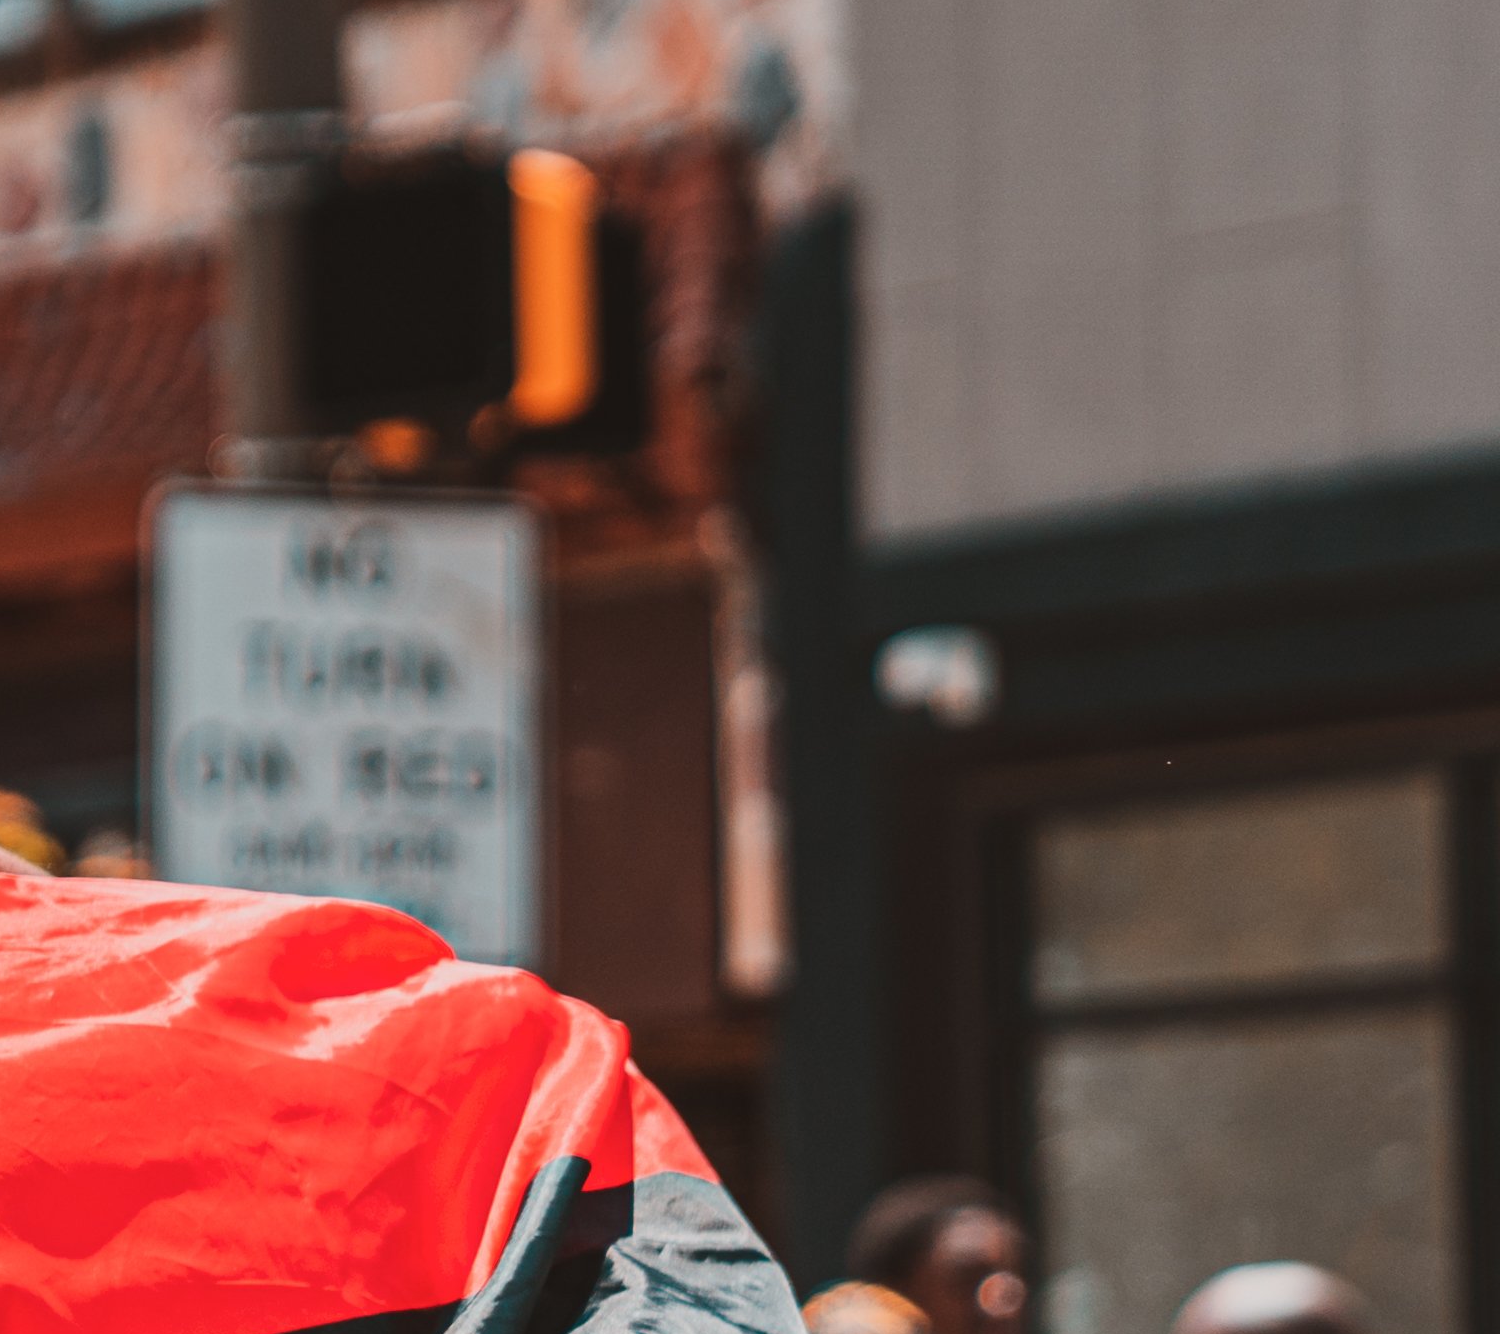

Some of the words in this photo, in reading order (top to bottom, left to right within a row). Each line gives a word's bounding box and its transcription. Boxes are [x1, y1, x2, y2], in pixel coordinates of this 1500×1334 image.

[284, 517, 396, 597] NO
[242, 619, 456, 707] TURN
[172, 721, 298, 809] ON
[342, 723, 502, 813] RED
